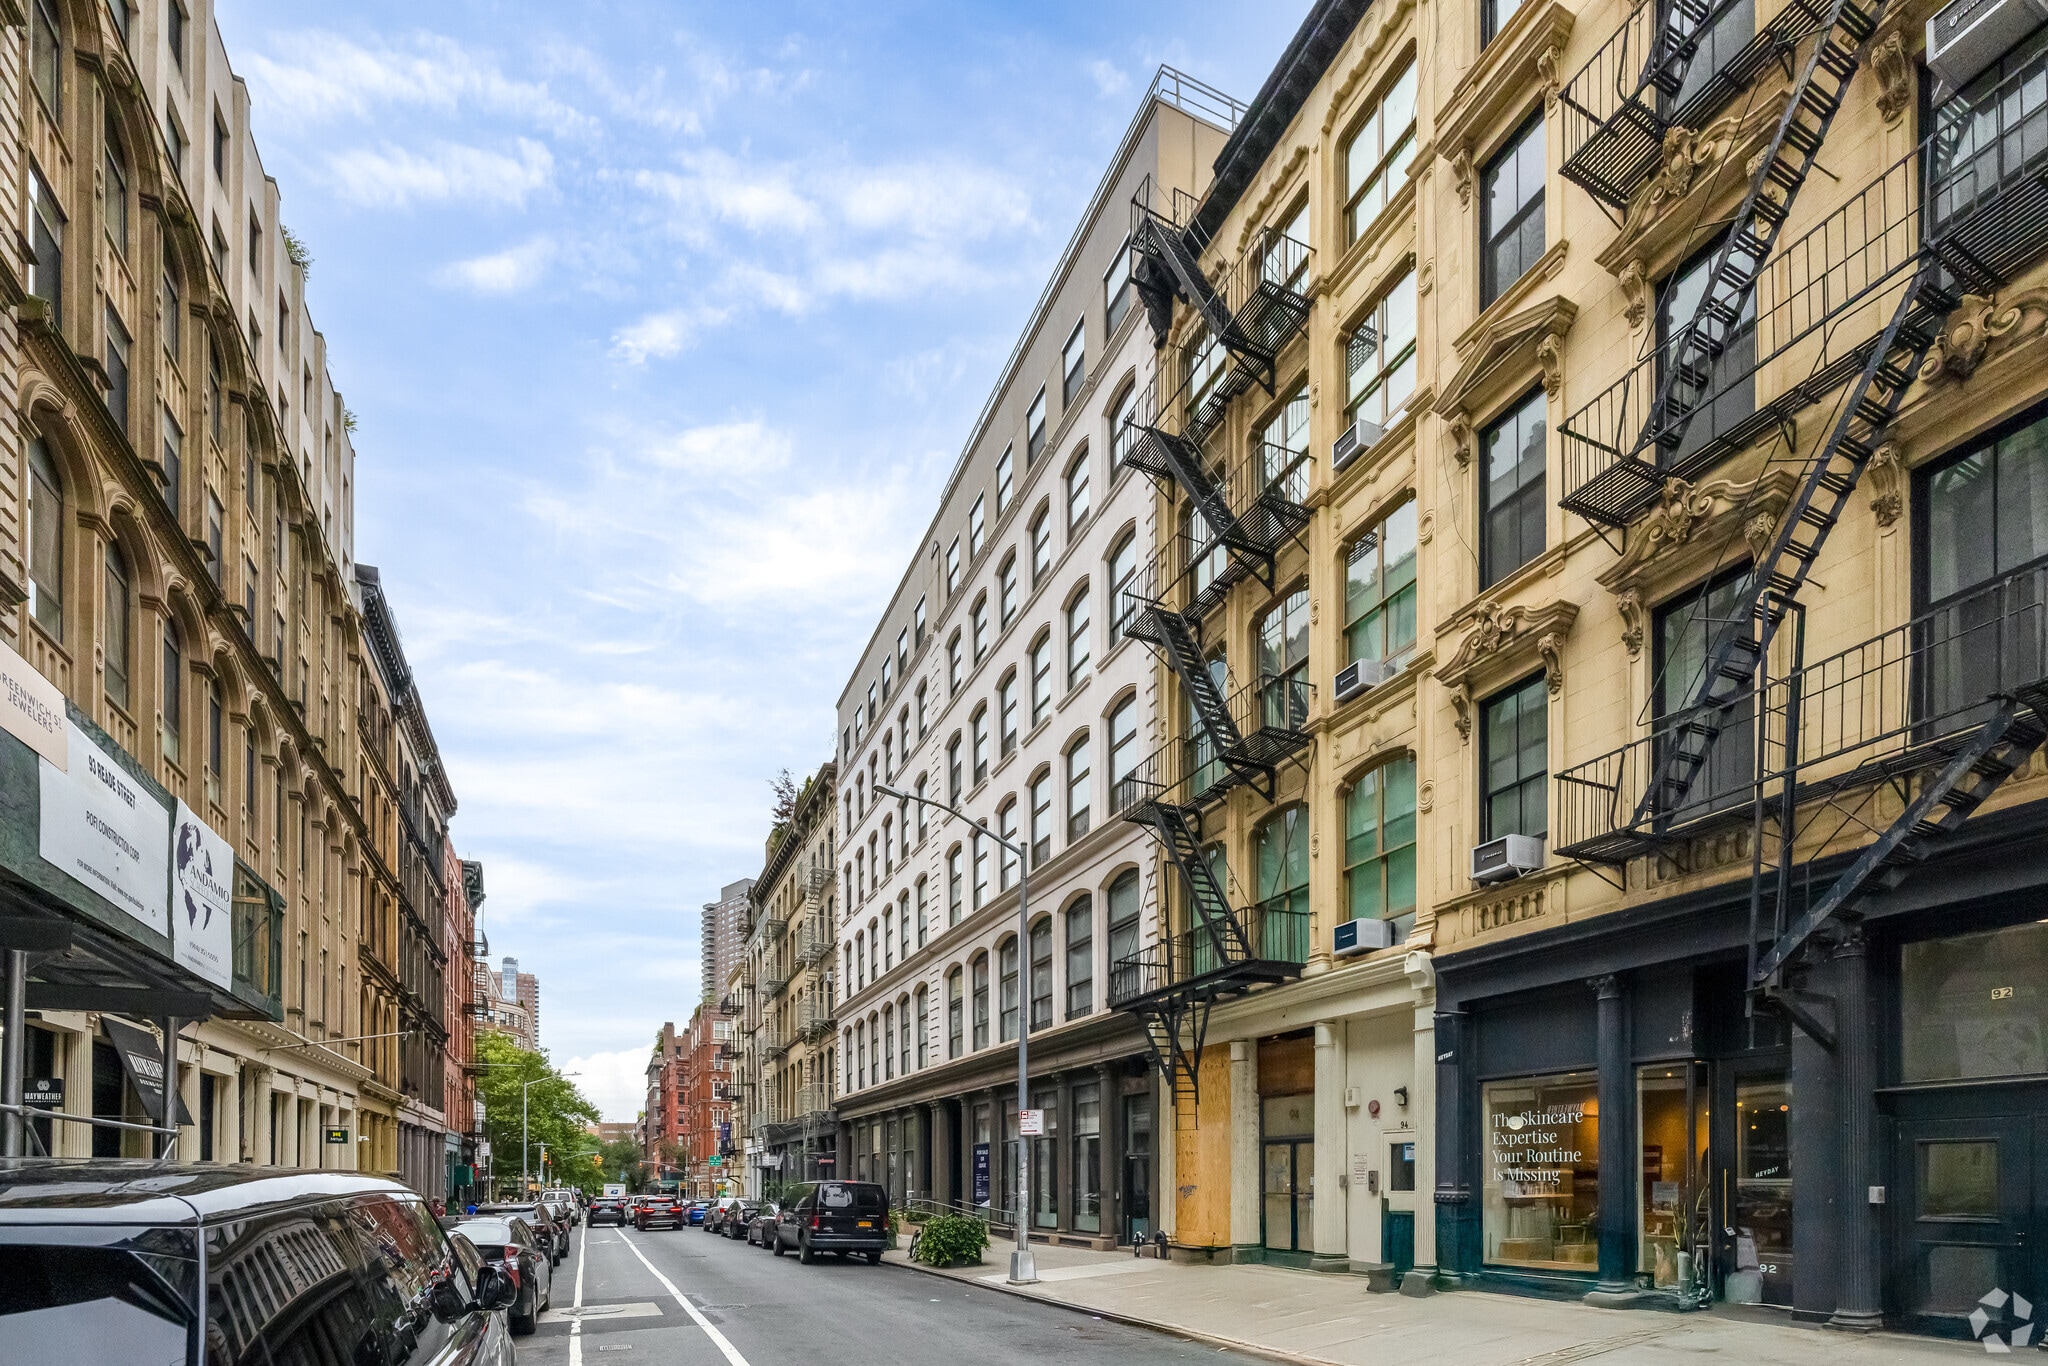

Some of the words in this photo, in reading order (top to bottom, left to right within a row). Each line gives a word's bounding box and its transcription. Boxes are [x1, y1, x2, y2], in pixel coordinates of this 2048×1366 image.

[7, 691, 53, 734] JEWELERS
[88, 754, 97, 776] 93
[97, 761, 117, 793] READE
[116, 779, 136, 810] STREET
[98, 819, 130, 855] CONSTRUCTION
[190, 865, 230, 903] ANDAMIO
[1992, 987, 2012, 999] 92
[1400, 1120, 1409, 1129] 94
[1520, 1109, 1584, 1127] Skincare
[1493, 1128, 1558, 1148] Expertise
[1492, 1149, 1523, 1164] Your
[1526, 1147, 1582, 1163] Routine
[1493, 1167, 1504, 1182] Is
[1507, 1166, 1561, 1186] Missing
[1755, 1166, 1779, 1179] HEYDAY
[1759, 1263, 1777, 1274] 92
